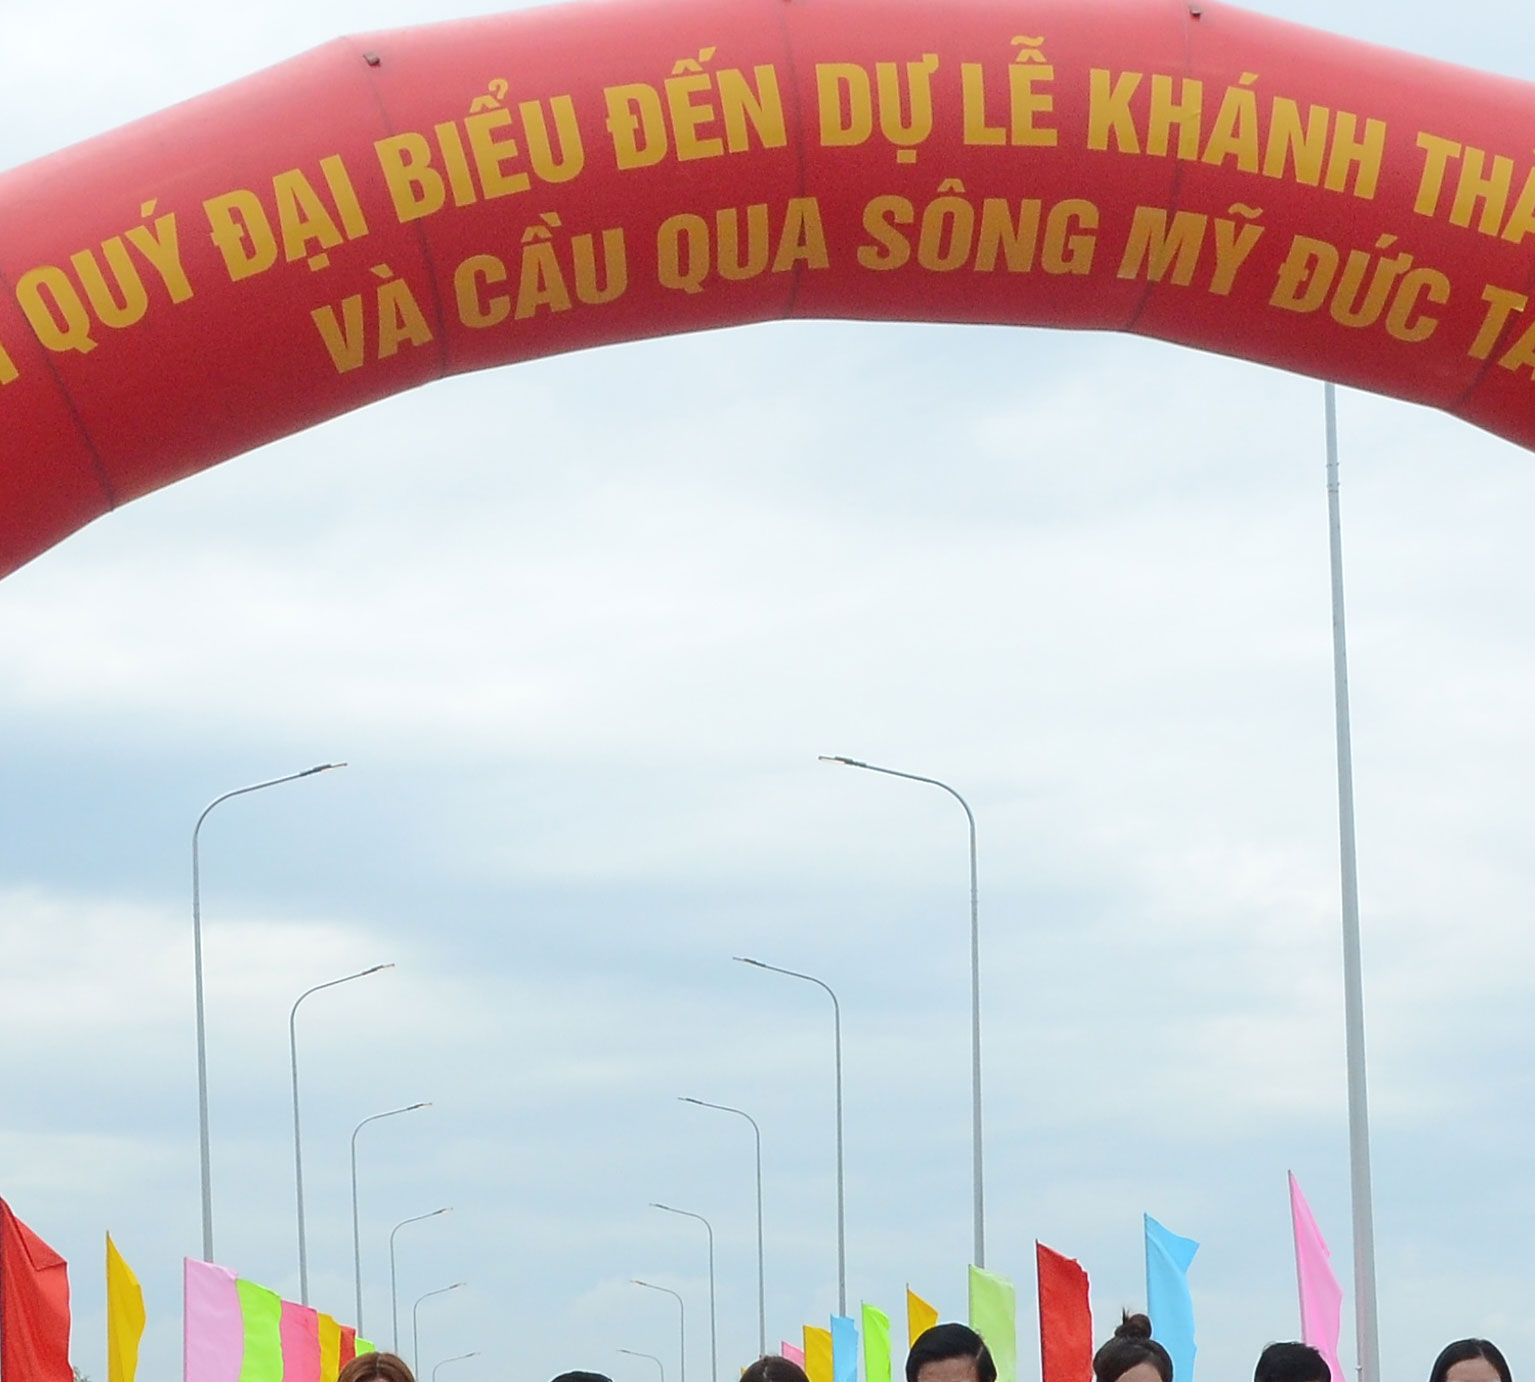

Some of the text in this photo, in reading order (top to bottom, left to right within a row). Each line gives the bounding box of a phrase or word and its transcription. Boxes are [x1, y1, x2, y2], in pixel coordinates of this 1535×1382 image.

[16, 199, 193, 353] QUÝ
[204, 154, 369, 281] ĐẠI
[375, 78, 585, 223] BIỂU
[604, 47, 788, 171] ĐẾN
[816, 53, 941, 164] DỰ
[962, 36, 1059, 147] LỄ
[1087, 68, 1388, 200] KHÁNH
[312, 280, 433, 372] VÀ
[454, 211, 628, 327] CẦU
[658, 197, 828, 293] QUA
[859, 178, 1100, 274] SÔNG
[1118, 203, 1263, 294] MỸ
[1271, 232, 1451, 341] ĐỨC
